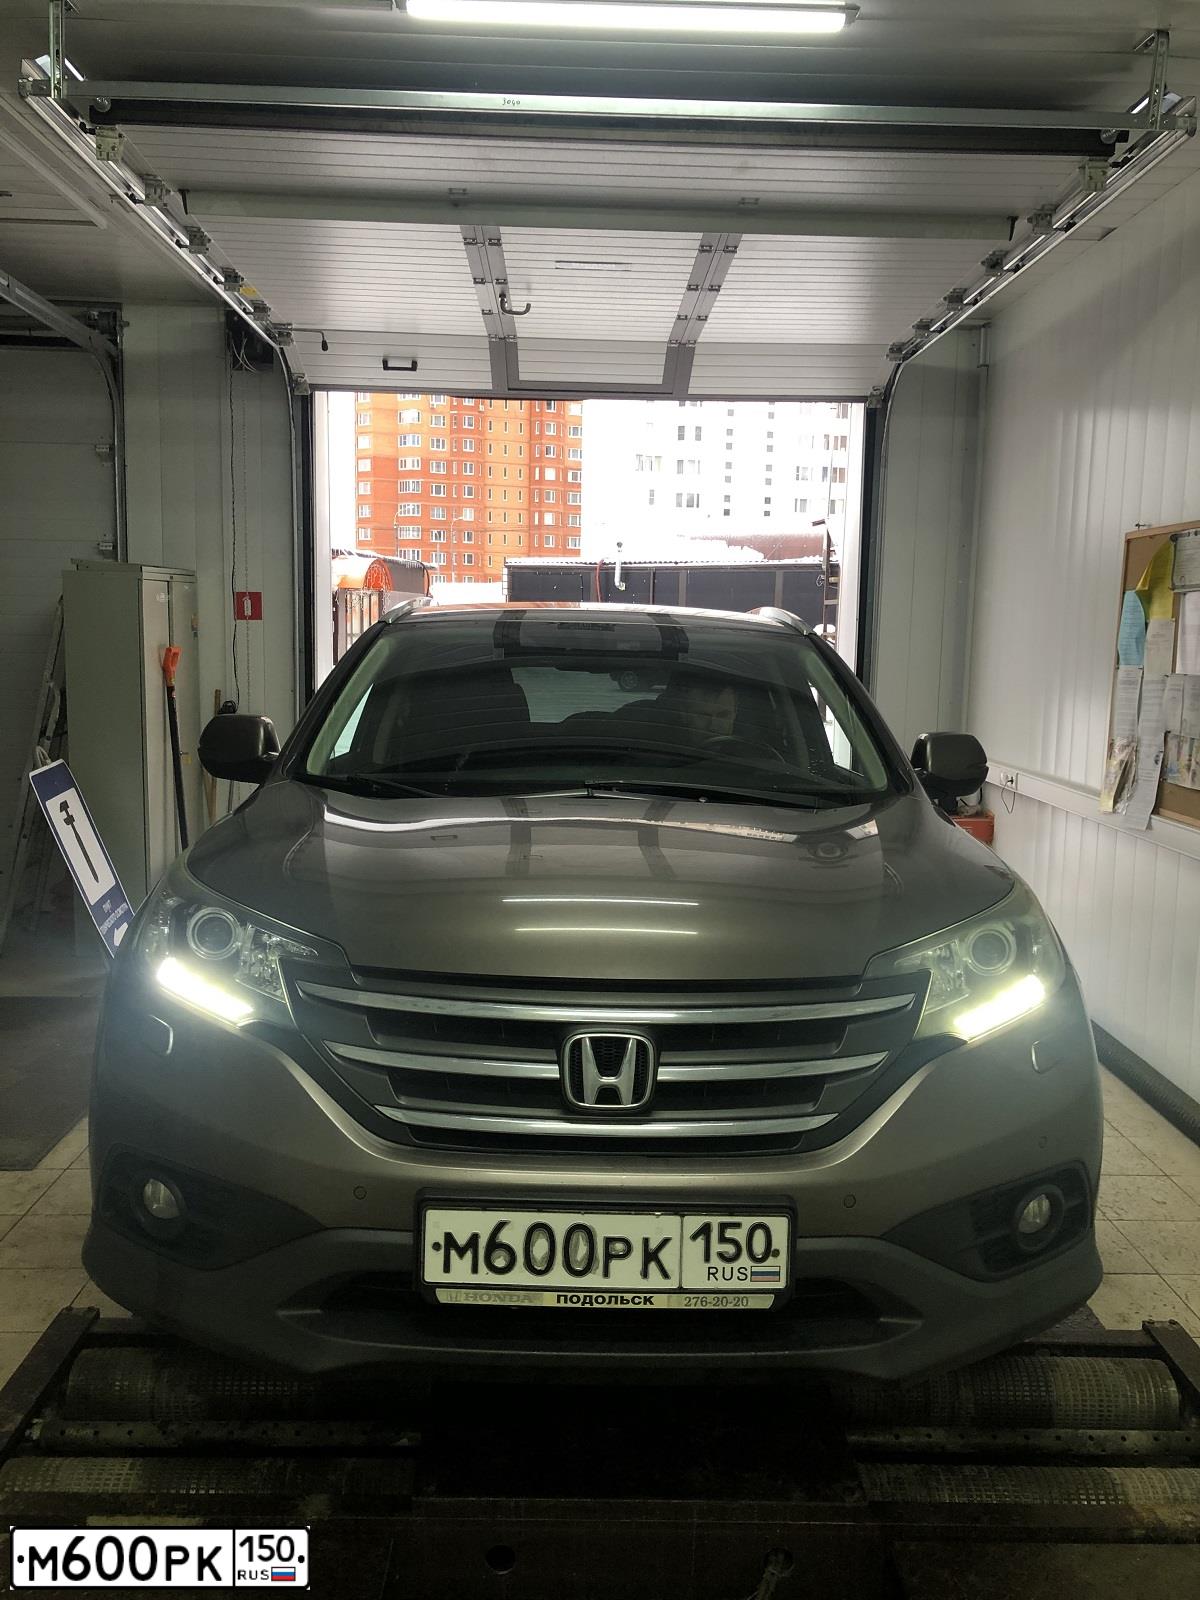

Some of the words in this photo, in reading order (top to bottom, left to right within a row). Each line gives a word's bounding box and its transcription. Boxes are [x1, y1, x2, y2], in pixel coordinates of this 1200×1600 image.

[442, 1219, 673, 1280] М600РК
[689, 1221, 773, 1264] 150
[707, 1266, 748, 1281] RUS
[556, 1294, 655, 1306] ПОДОЛЬСК
[684, 1296, 749, 1307] 276-20-20
